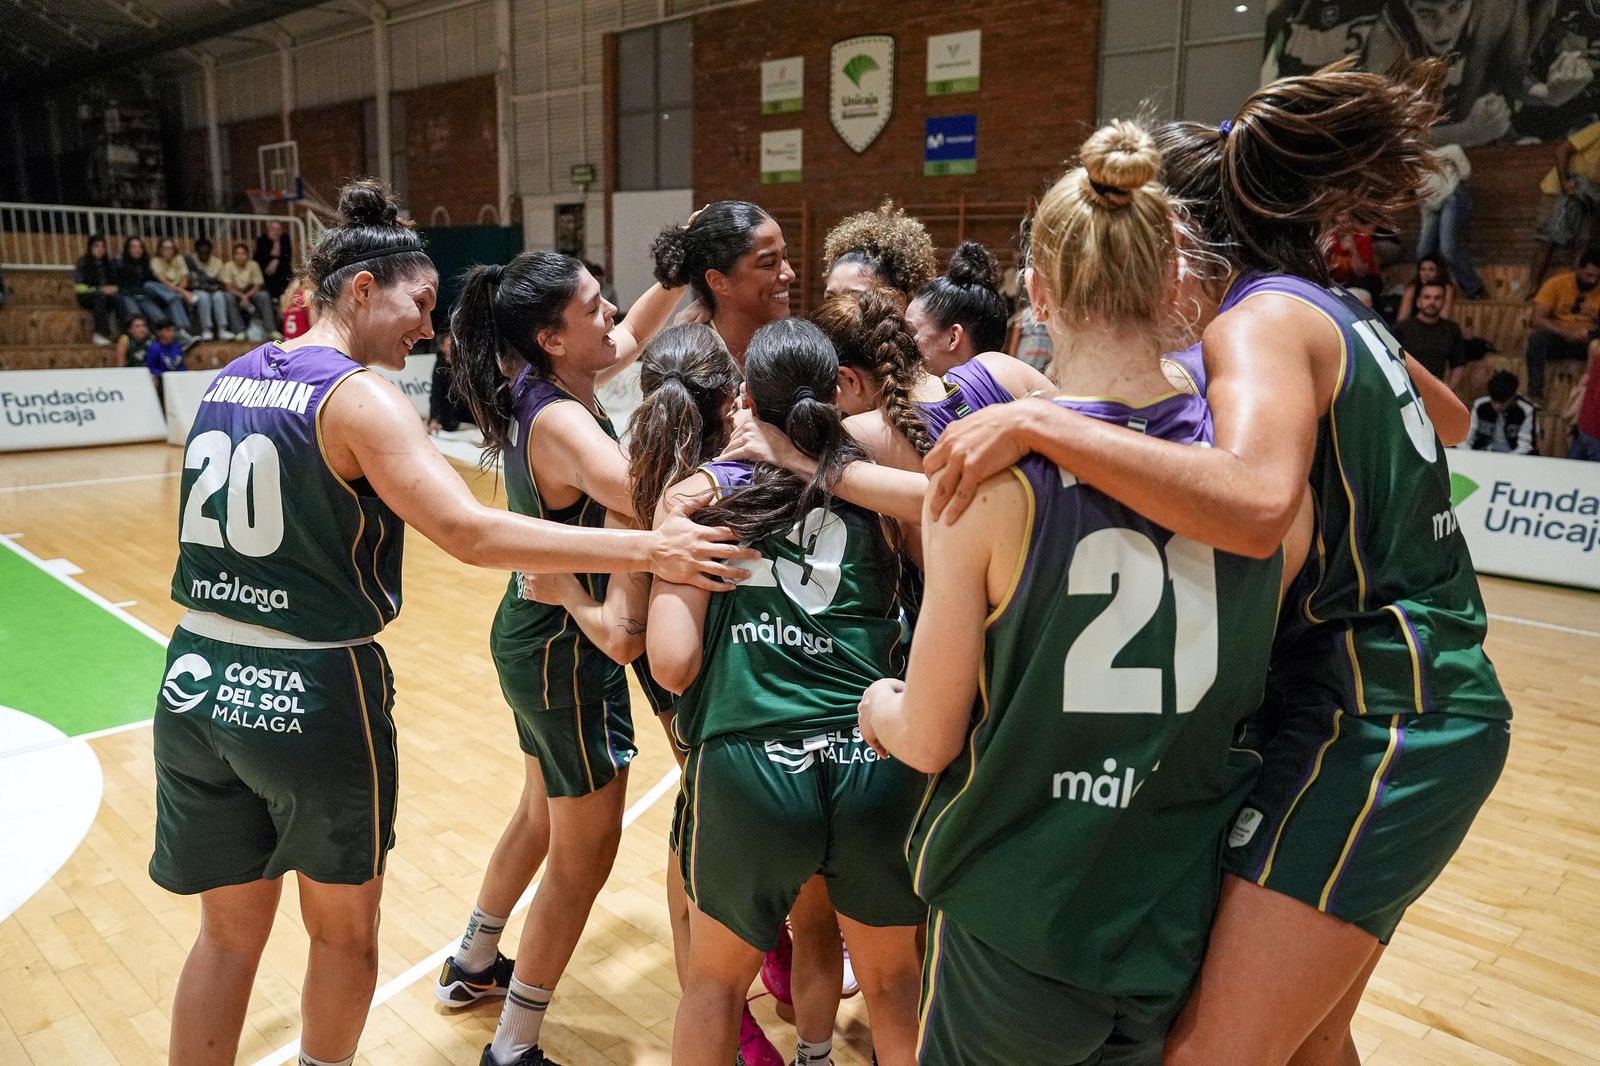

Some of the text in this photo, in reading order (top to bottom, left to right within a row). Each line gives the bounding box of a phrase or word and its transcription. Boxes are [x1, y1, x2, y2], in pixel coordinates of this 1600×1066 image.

[1, 386, 124, 408] Fundación
[390, 377, 432, 396] Unic
[6, 406, 96, 427] Unicaja
[180, 430, 285, 558] 20
[1484, 508, 1600, 552] Unicaj
[1062, 527, 1219, 715] 21
[225, 662, 306, 692] COSTA
[216, 685, 304, 714] DEL SOL
[211, 703, 303, 734] MÁLAGA
[1052, 757, 1140, 809] mál
